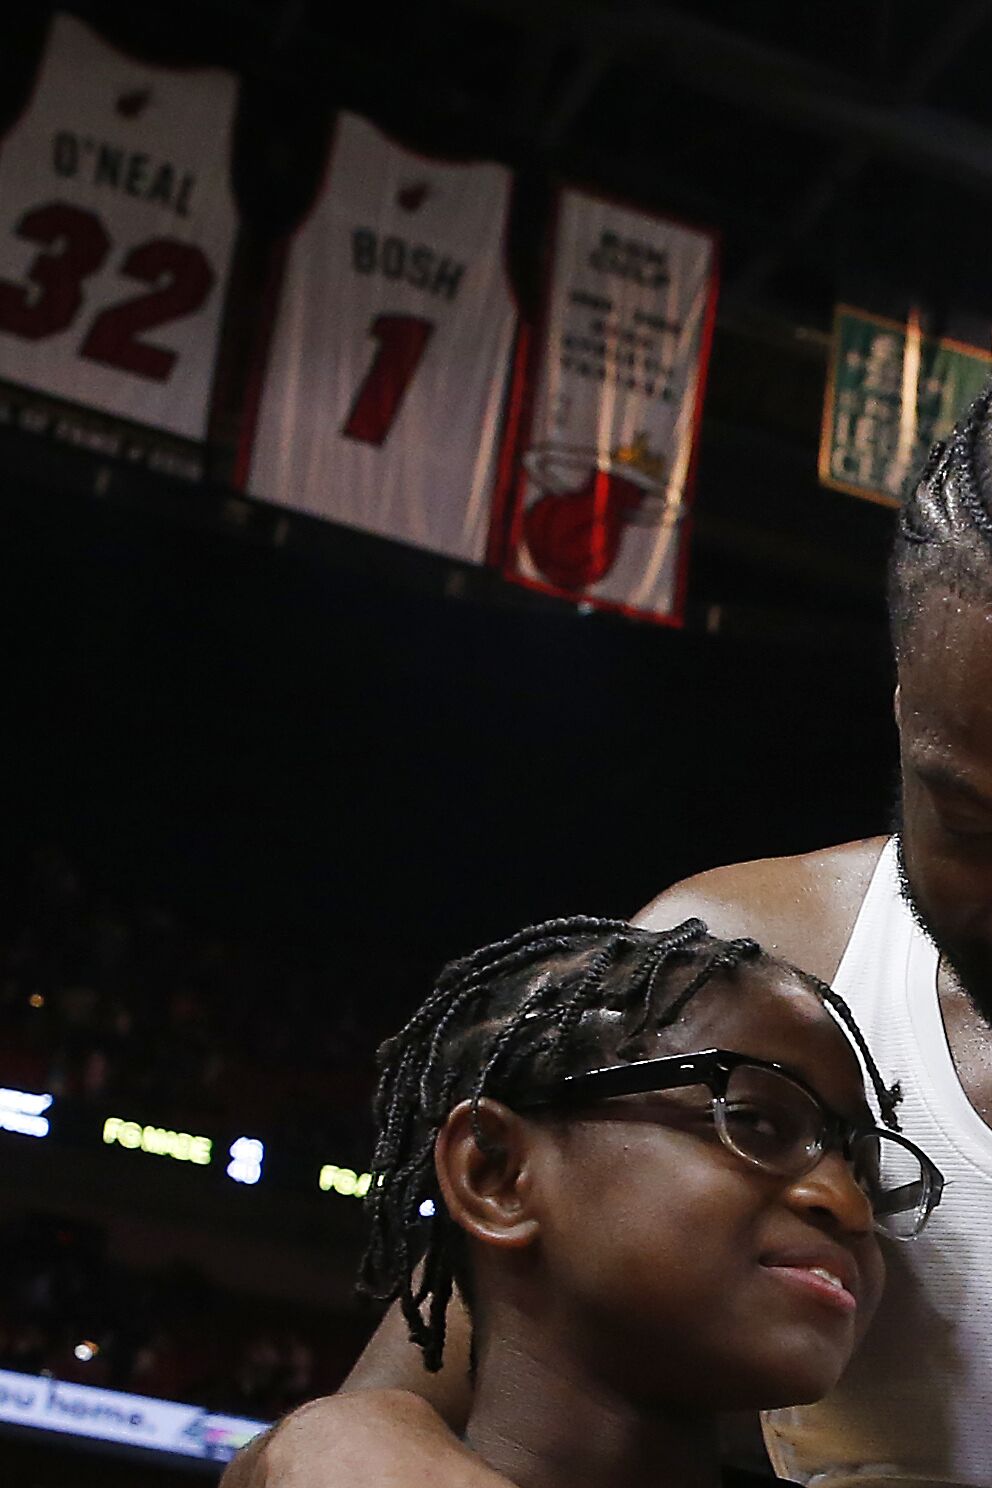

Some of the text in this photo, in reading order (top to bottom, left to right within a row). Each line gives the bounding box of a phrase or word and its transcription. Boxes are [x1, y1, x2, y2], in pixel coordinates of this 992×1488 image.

[53, 129, 196, 218] O'NEAL
[0, 203, 217, 386] 32
[349, 228, 468, 300] BOSH
[342, 315, 435, 449] 1
